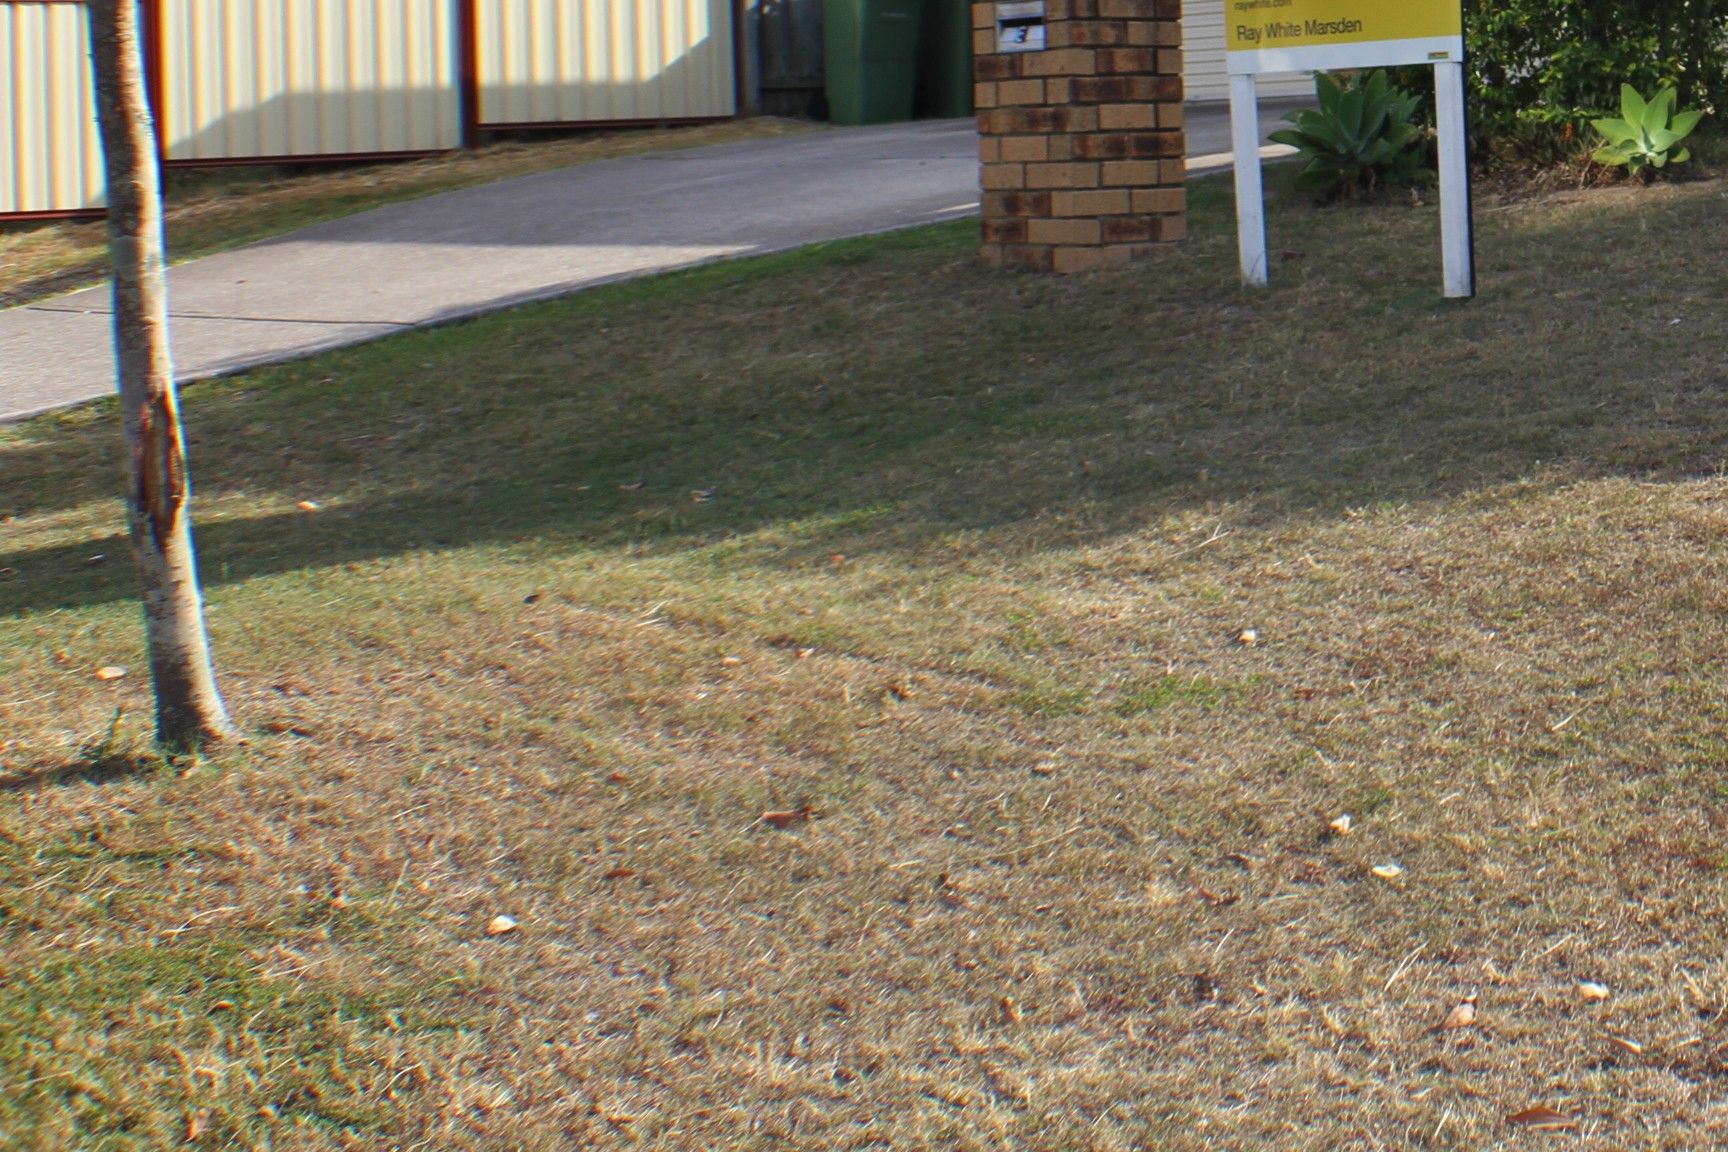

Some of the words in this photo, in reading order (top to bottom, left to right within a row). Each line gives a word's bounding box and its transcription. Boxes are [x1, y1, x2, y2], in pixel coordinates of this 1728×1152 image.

[1237, 25, 1262, 44] Ray
[1265, 21, 1301, 39] White
[1305, 17, 1362, 36] Marsden
